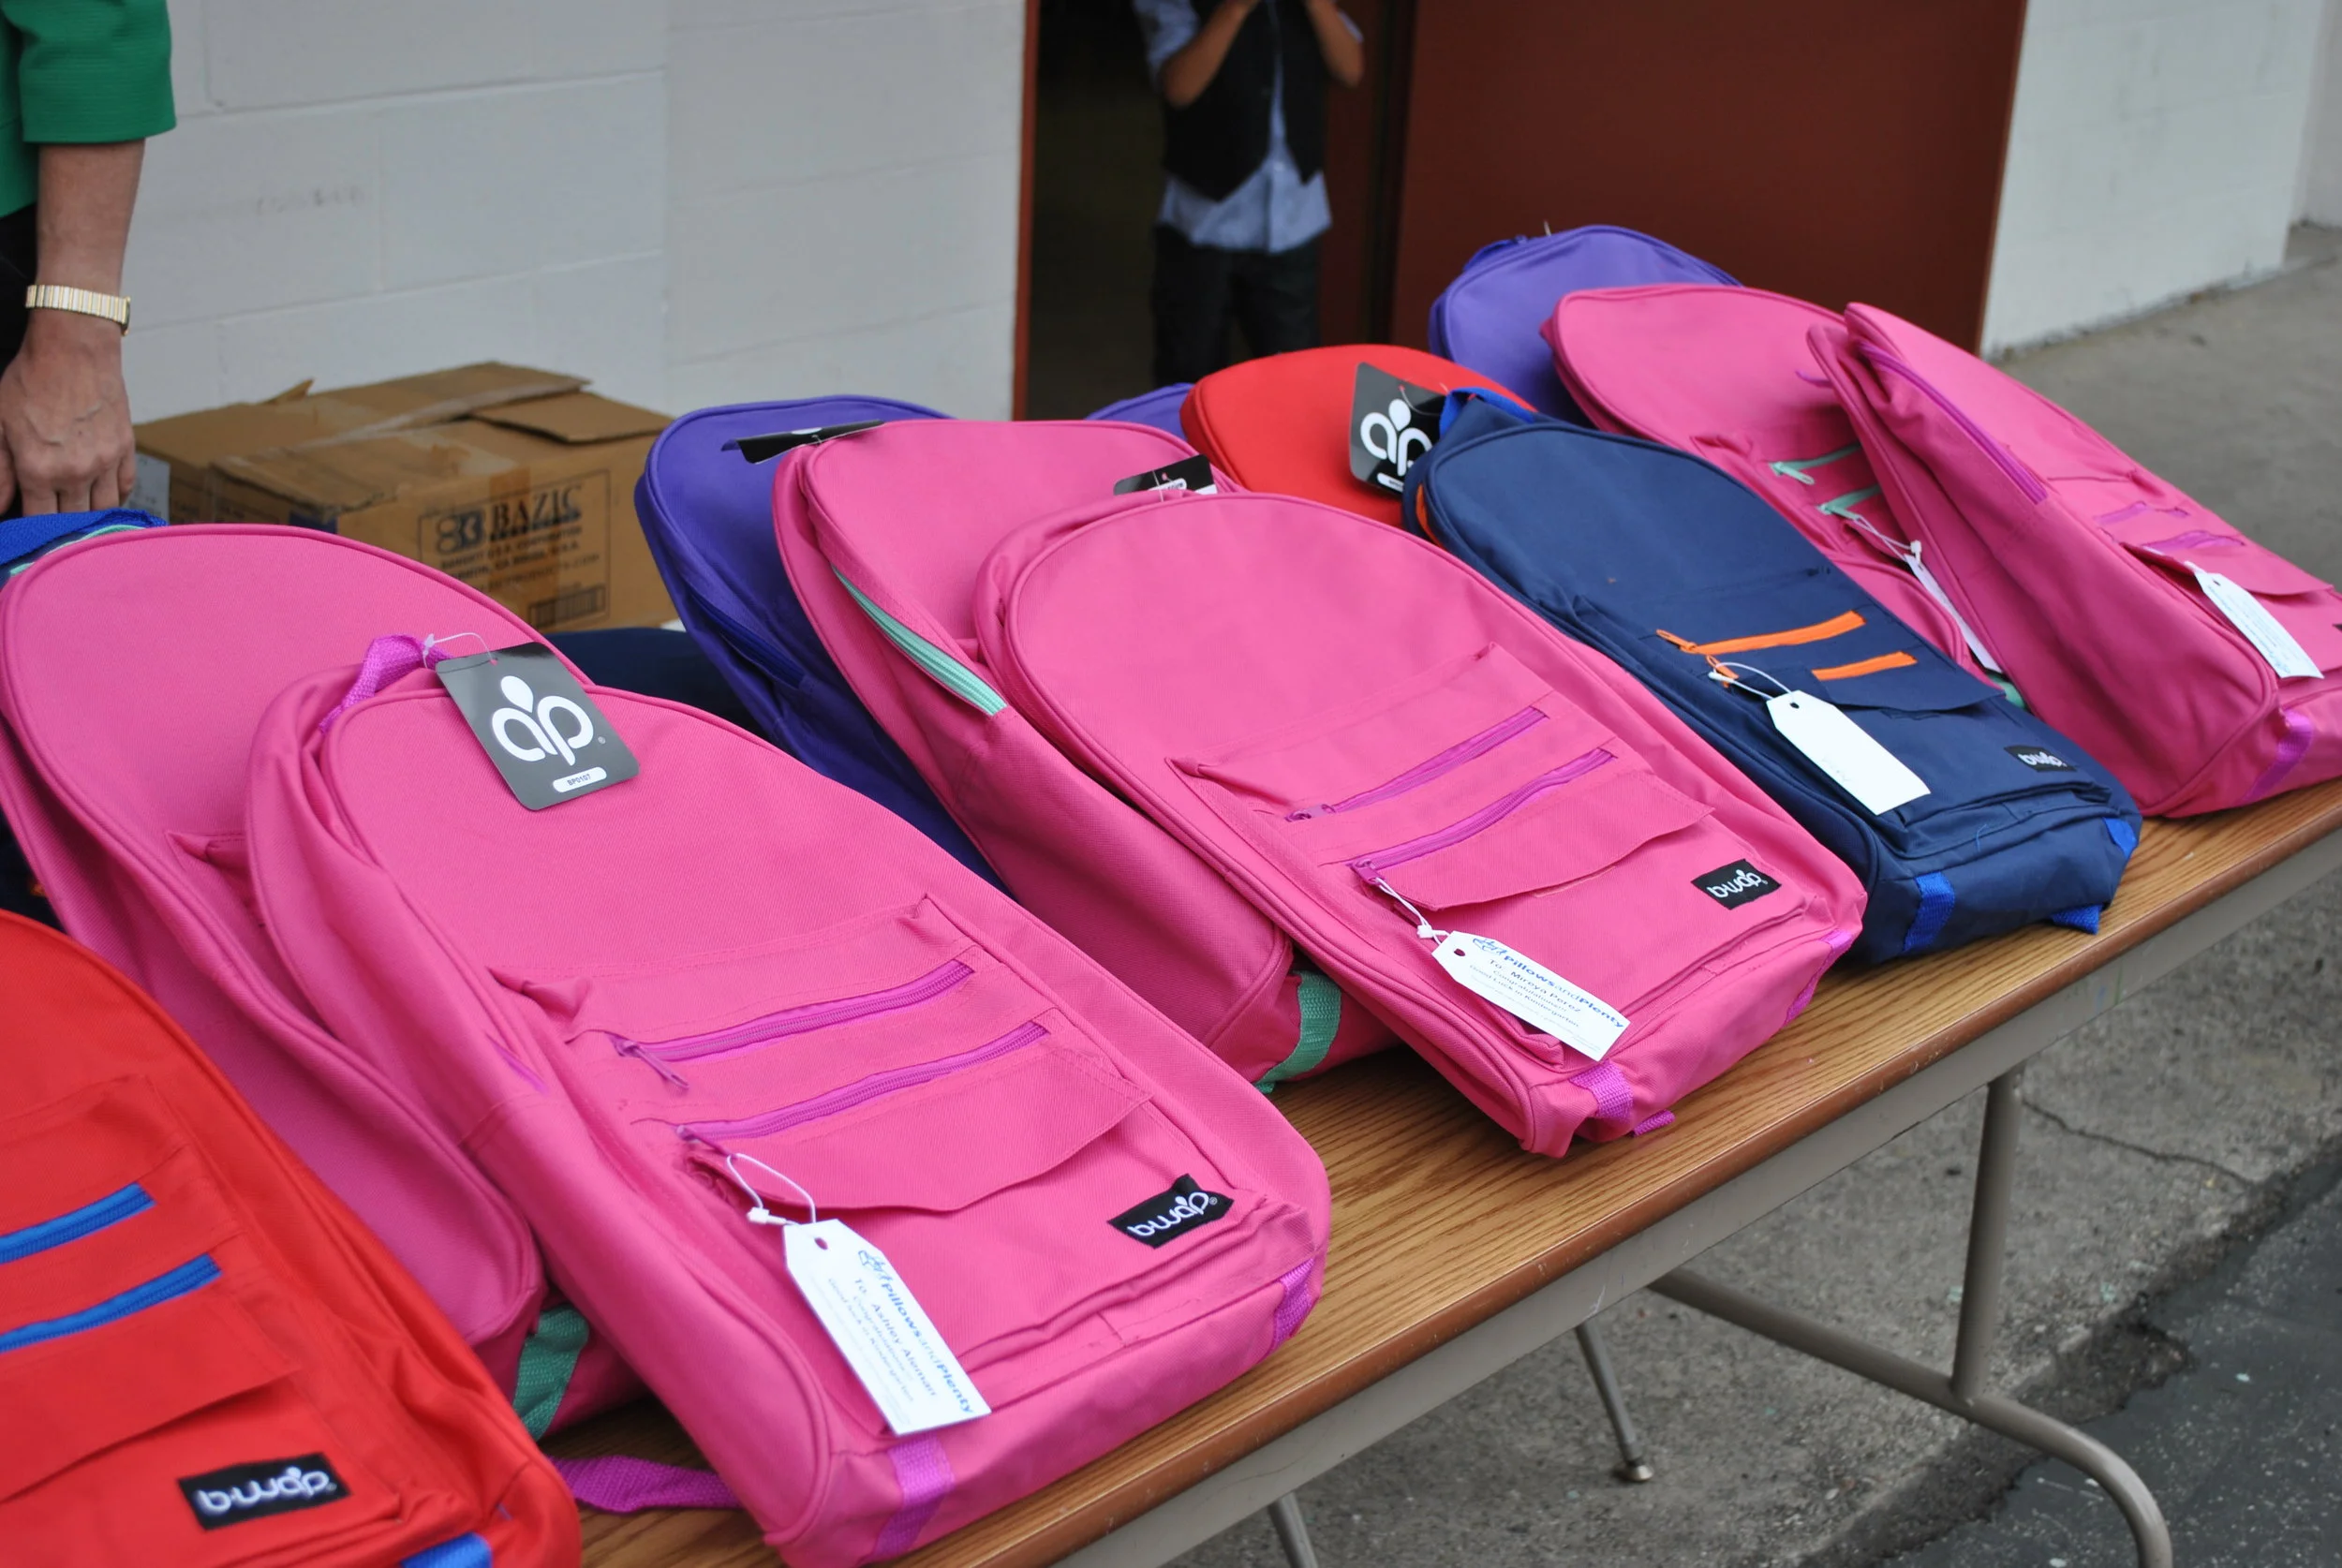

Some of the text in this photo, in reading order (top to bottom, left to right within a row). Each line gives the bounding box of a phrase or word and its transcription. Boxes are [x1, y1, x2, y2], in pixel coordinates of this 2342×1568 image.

[490, 483, 582, 533] BAZIC
[1505, 955, 1624, 1028] PillowsandPlenty
[1510, 971, 1547, 995] Mireya
[1549, 993, 1580, 1013] Perez
[871, 1302, 901, 1344] Ashley
[881, 1282, 973, 1413] PillowsandPlenty
